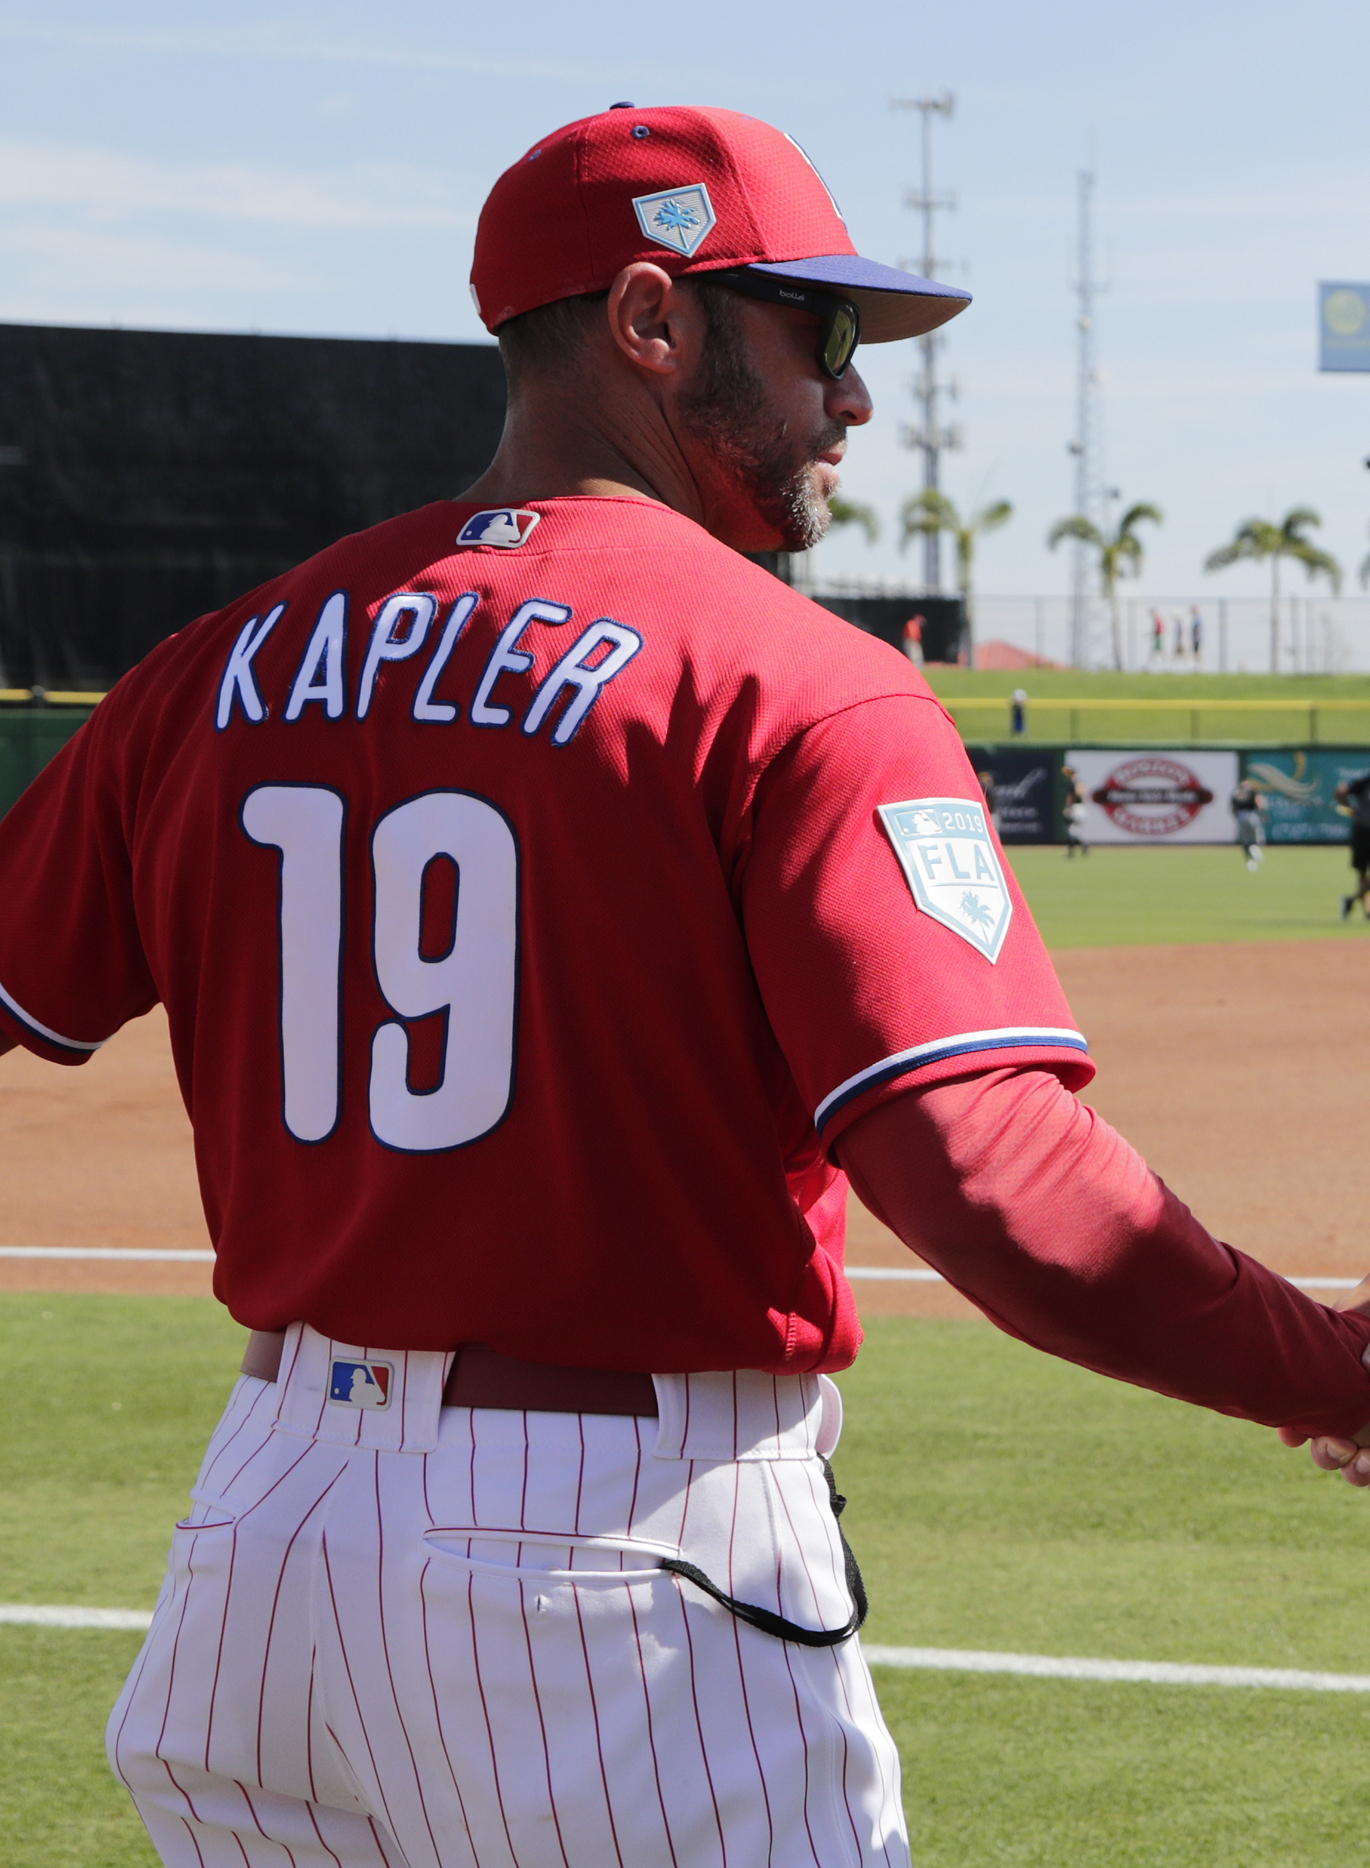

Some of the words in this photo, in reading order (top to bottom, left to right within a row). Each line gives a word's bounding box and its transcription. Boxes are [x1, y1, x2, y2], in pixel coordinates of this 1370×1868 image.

[779, 289, 805, 301] bollé
[214, 589, 645, 749] KAPLER
[942, 811, 983, 833] 2019
[917, 842, 995, 881] FLA
[239, 780, 521, 1155] 19
